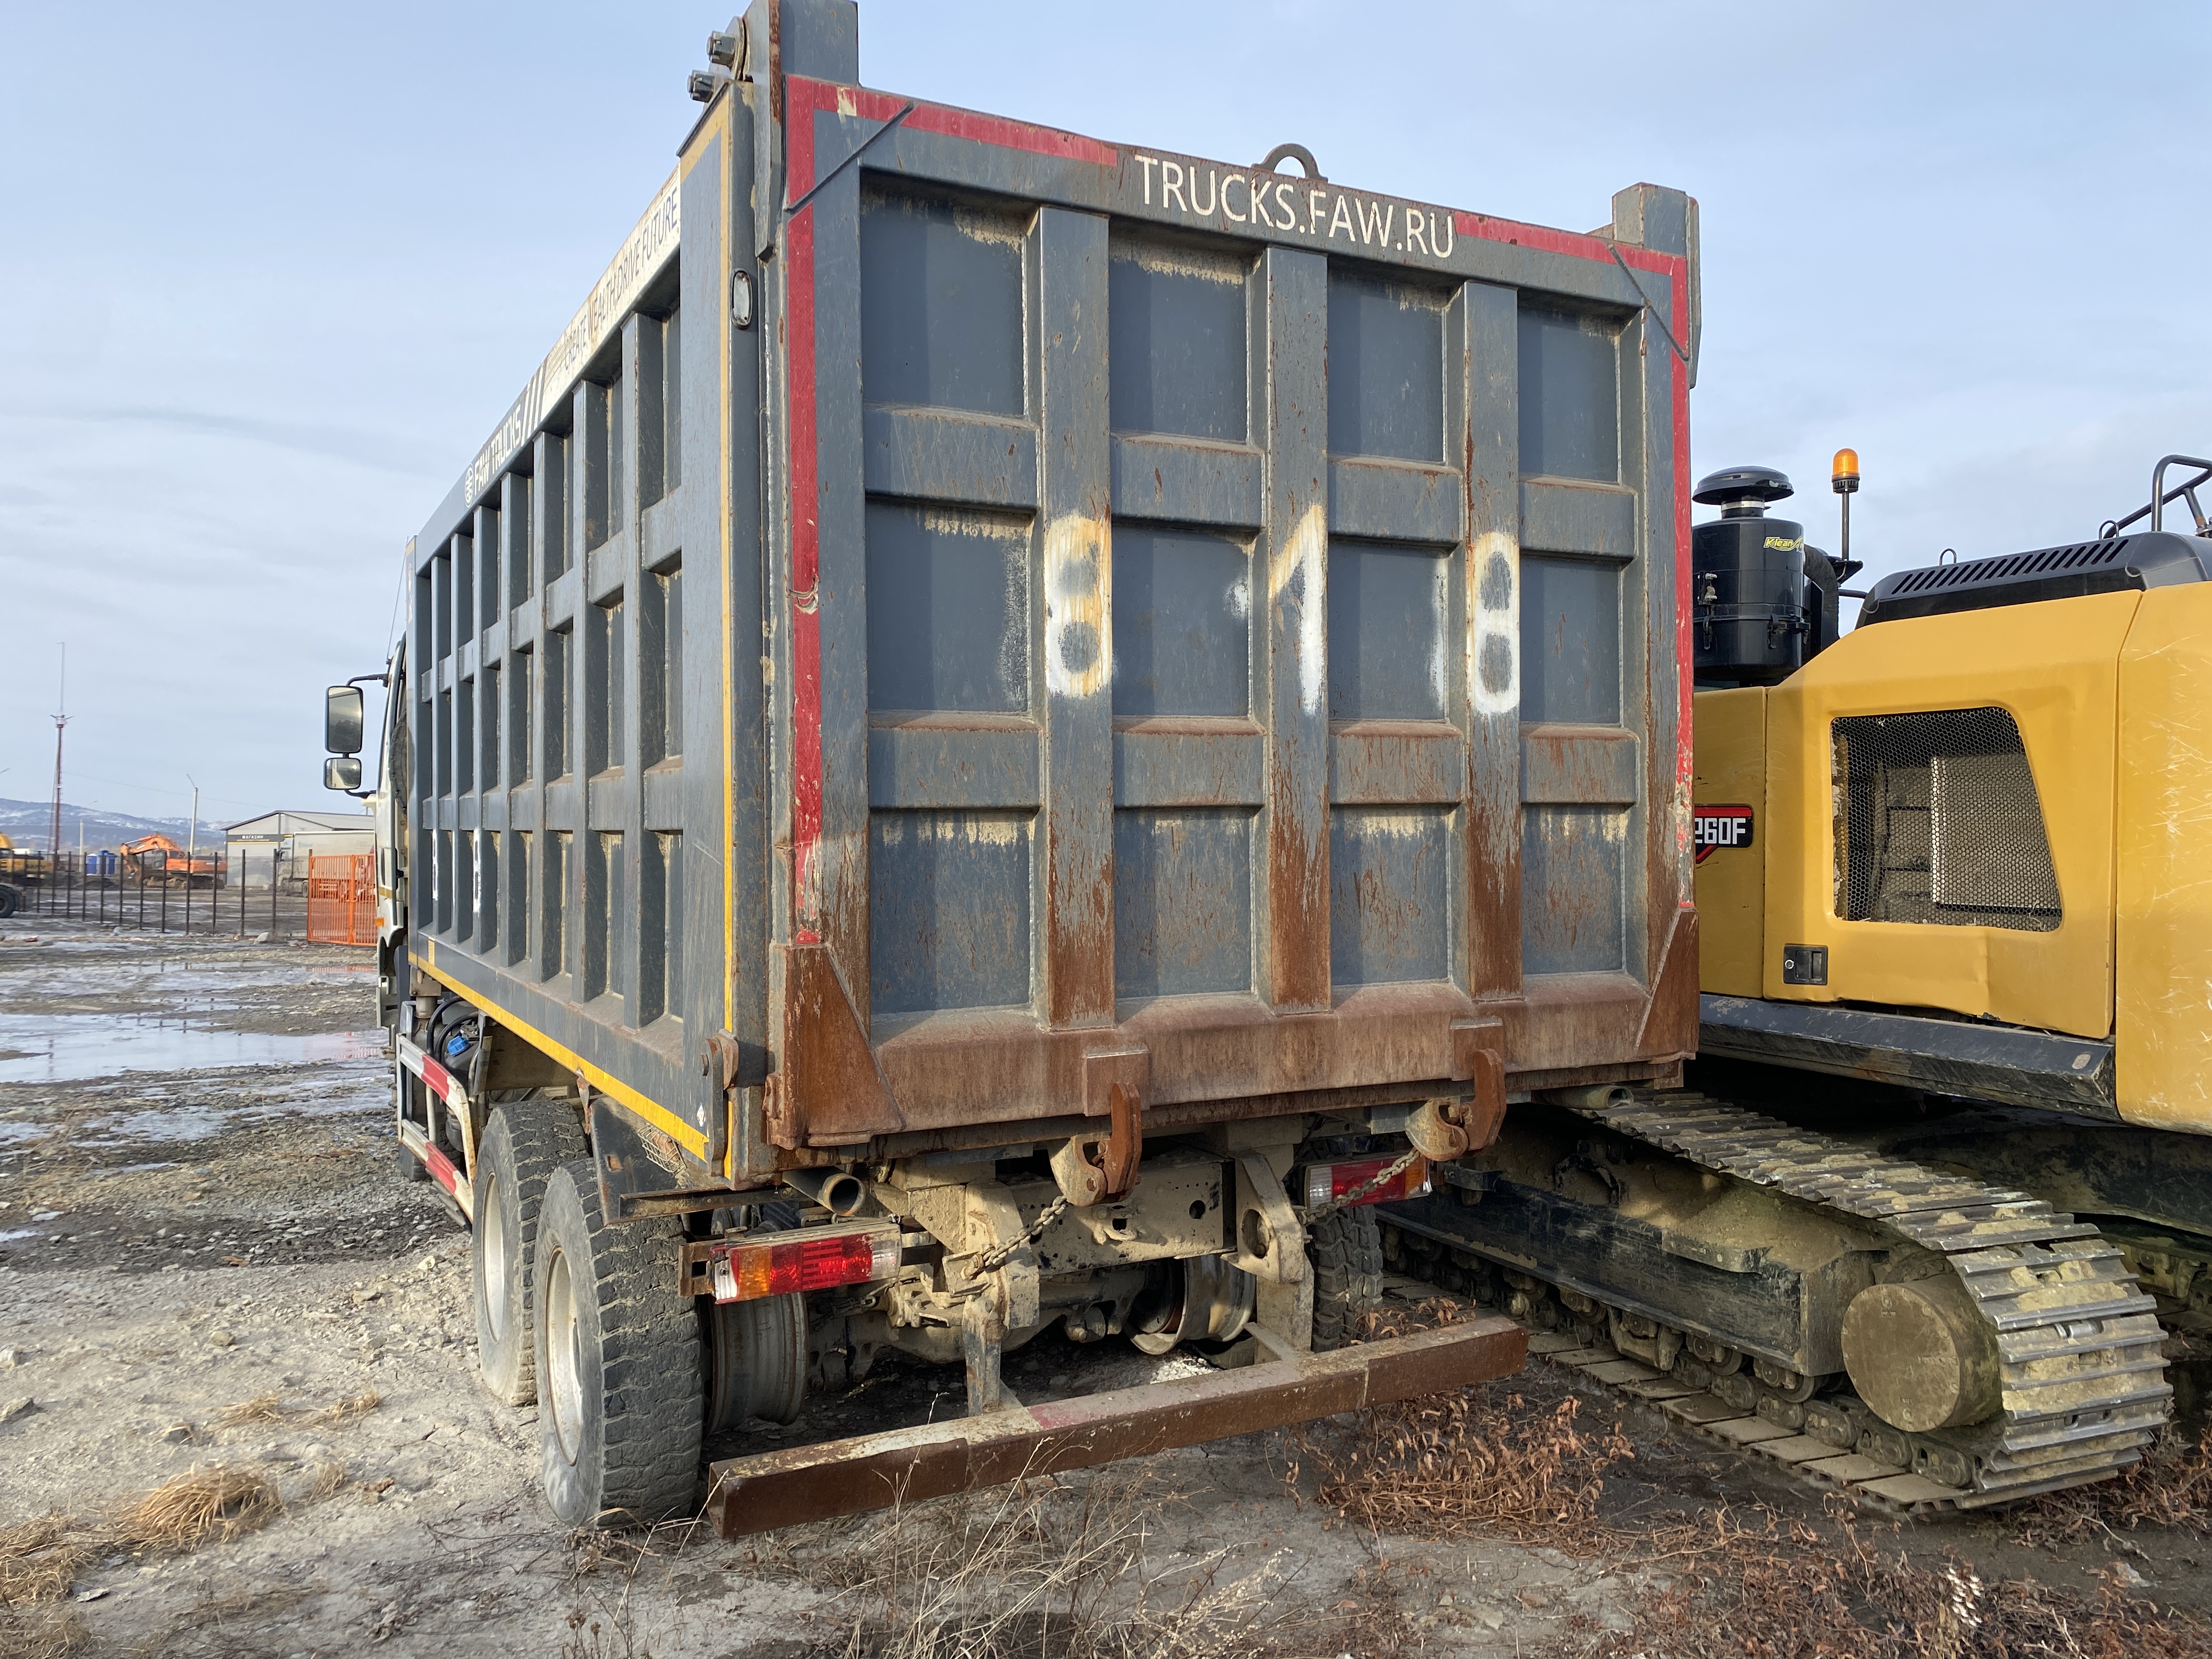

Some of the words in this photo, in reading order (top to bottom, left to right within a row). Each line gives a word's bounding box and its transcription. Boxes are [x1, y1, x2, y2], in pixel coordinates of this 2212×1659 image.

[617, 238, 640, 301] DRIVE
[642, 186, 678, 268] FUTURE
[1135, 155, 1454, 258] TRUCKS.FAW.RU
[474, 445, 490, 496] FAW
[490, 403, 521, 475] TRUCKS
